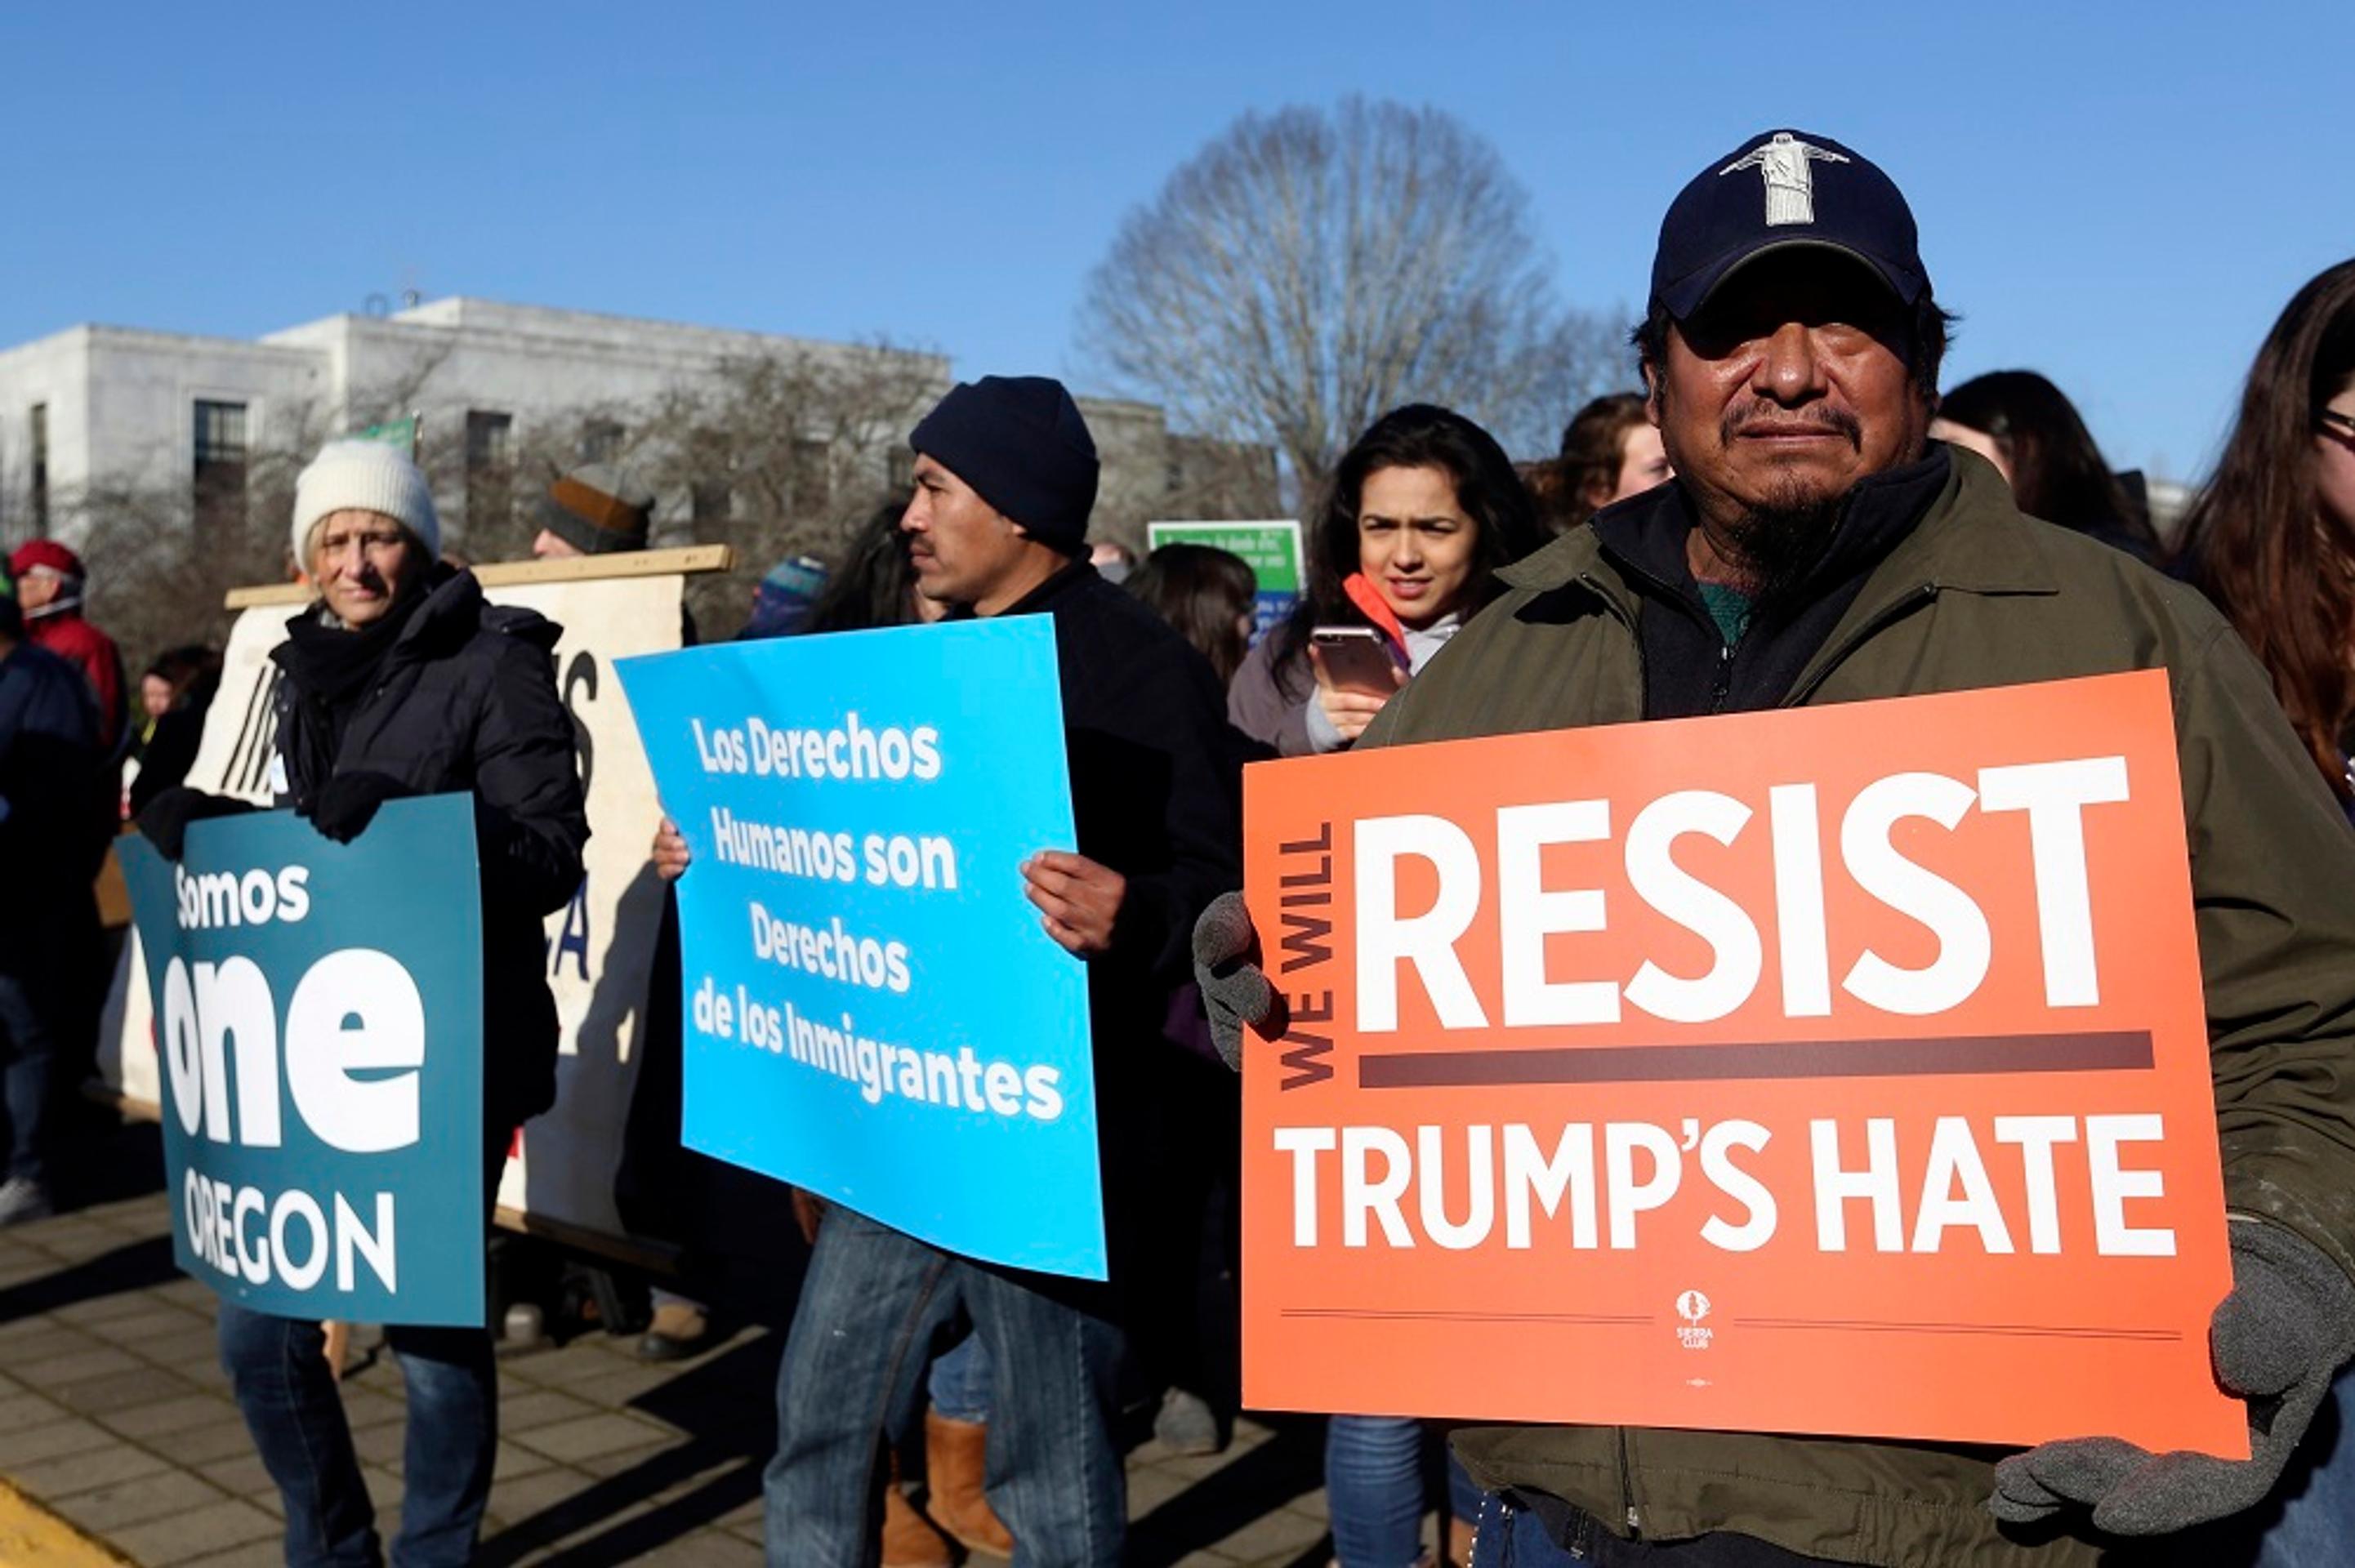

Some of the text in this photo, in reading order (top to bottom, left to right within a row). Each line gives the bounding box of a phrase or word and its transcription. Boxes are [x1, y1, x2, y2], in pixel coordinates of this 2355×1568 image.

[692, 711, 942, 780] Los Derechos
[176, 865, 310, 929] Somos
[711, 807, 957, 890] Humanos son
[1354, 756, 2130, 1032] RESIST
[749, 902, 911, 993] Derechos
[1280, 822, 1333, 1091] WE WILL
[164, 948, 425, 1152] one
[693, 977, 1064, 1120] de los Inmigrantes
[185, 1169, 396, 1294] OREGON
[1273, 1114, 2177, 1256] TRUMP'S HATE
